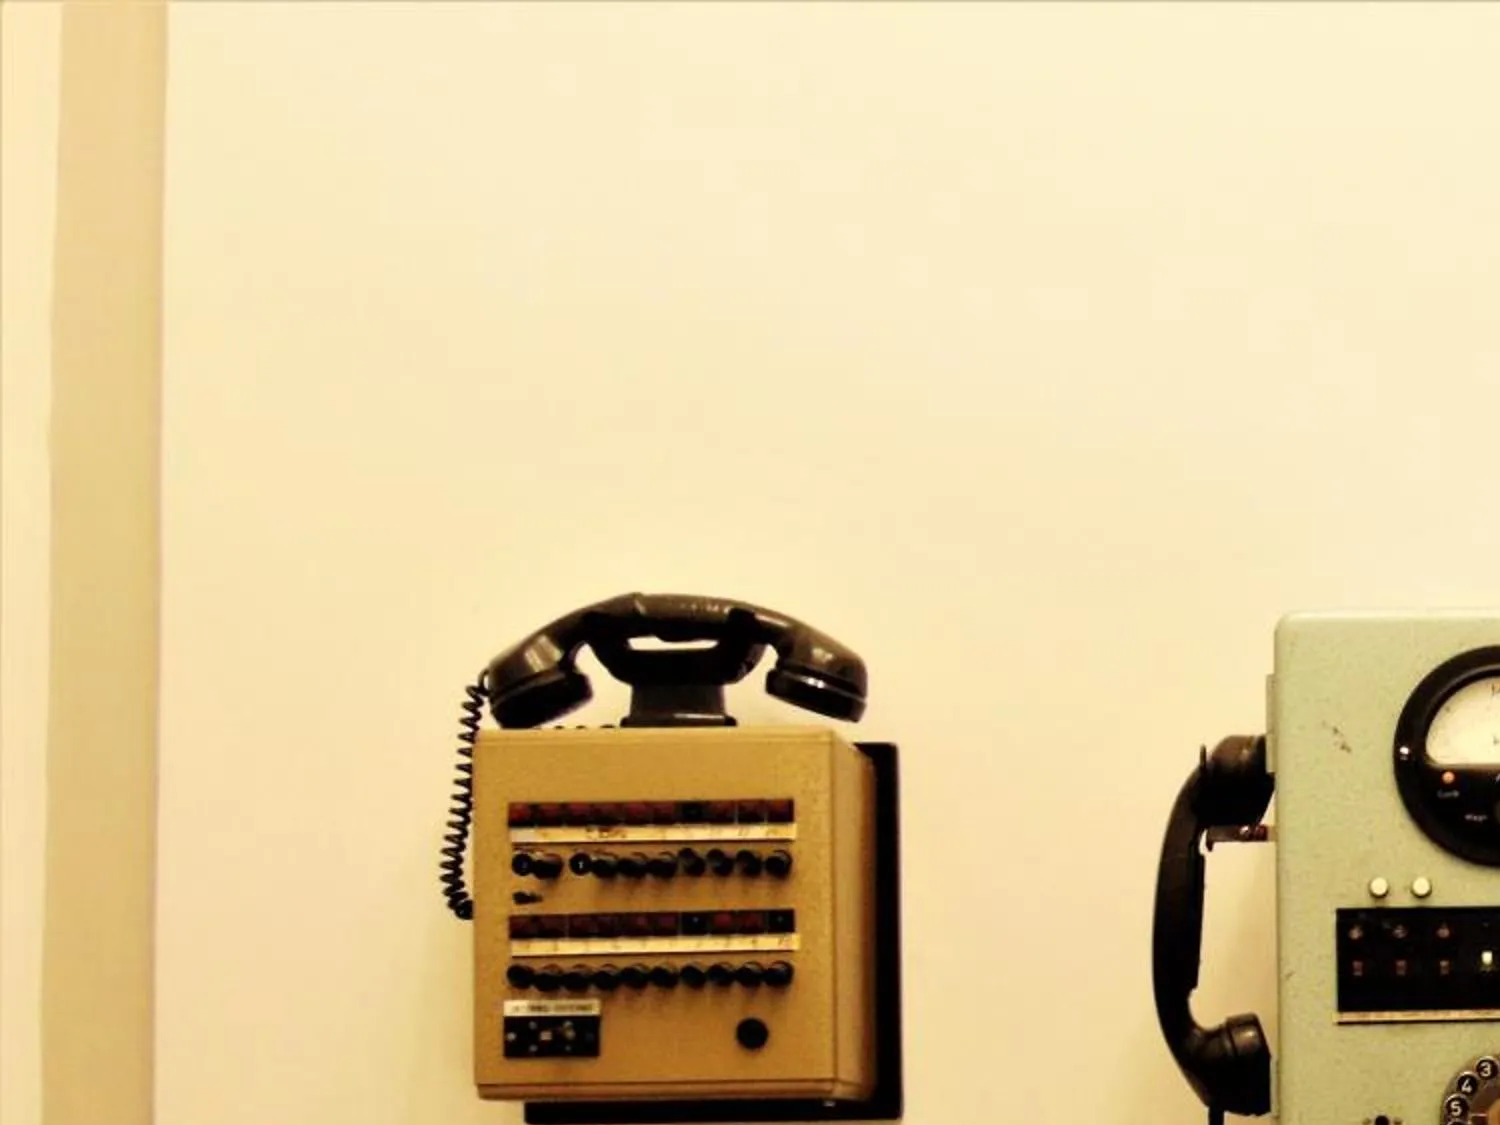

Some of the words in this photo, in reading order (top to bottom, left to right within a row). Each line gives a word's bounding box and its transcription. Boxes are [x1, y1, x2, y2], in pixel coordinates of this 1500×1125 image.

[1481, 1062, 1491, 1076] 3
[1461, 1079, 1473, 1093] 4
[1450, 1100, 1461, 1113] 5
